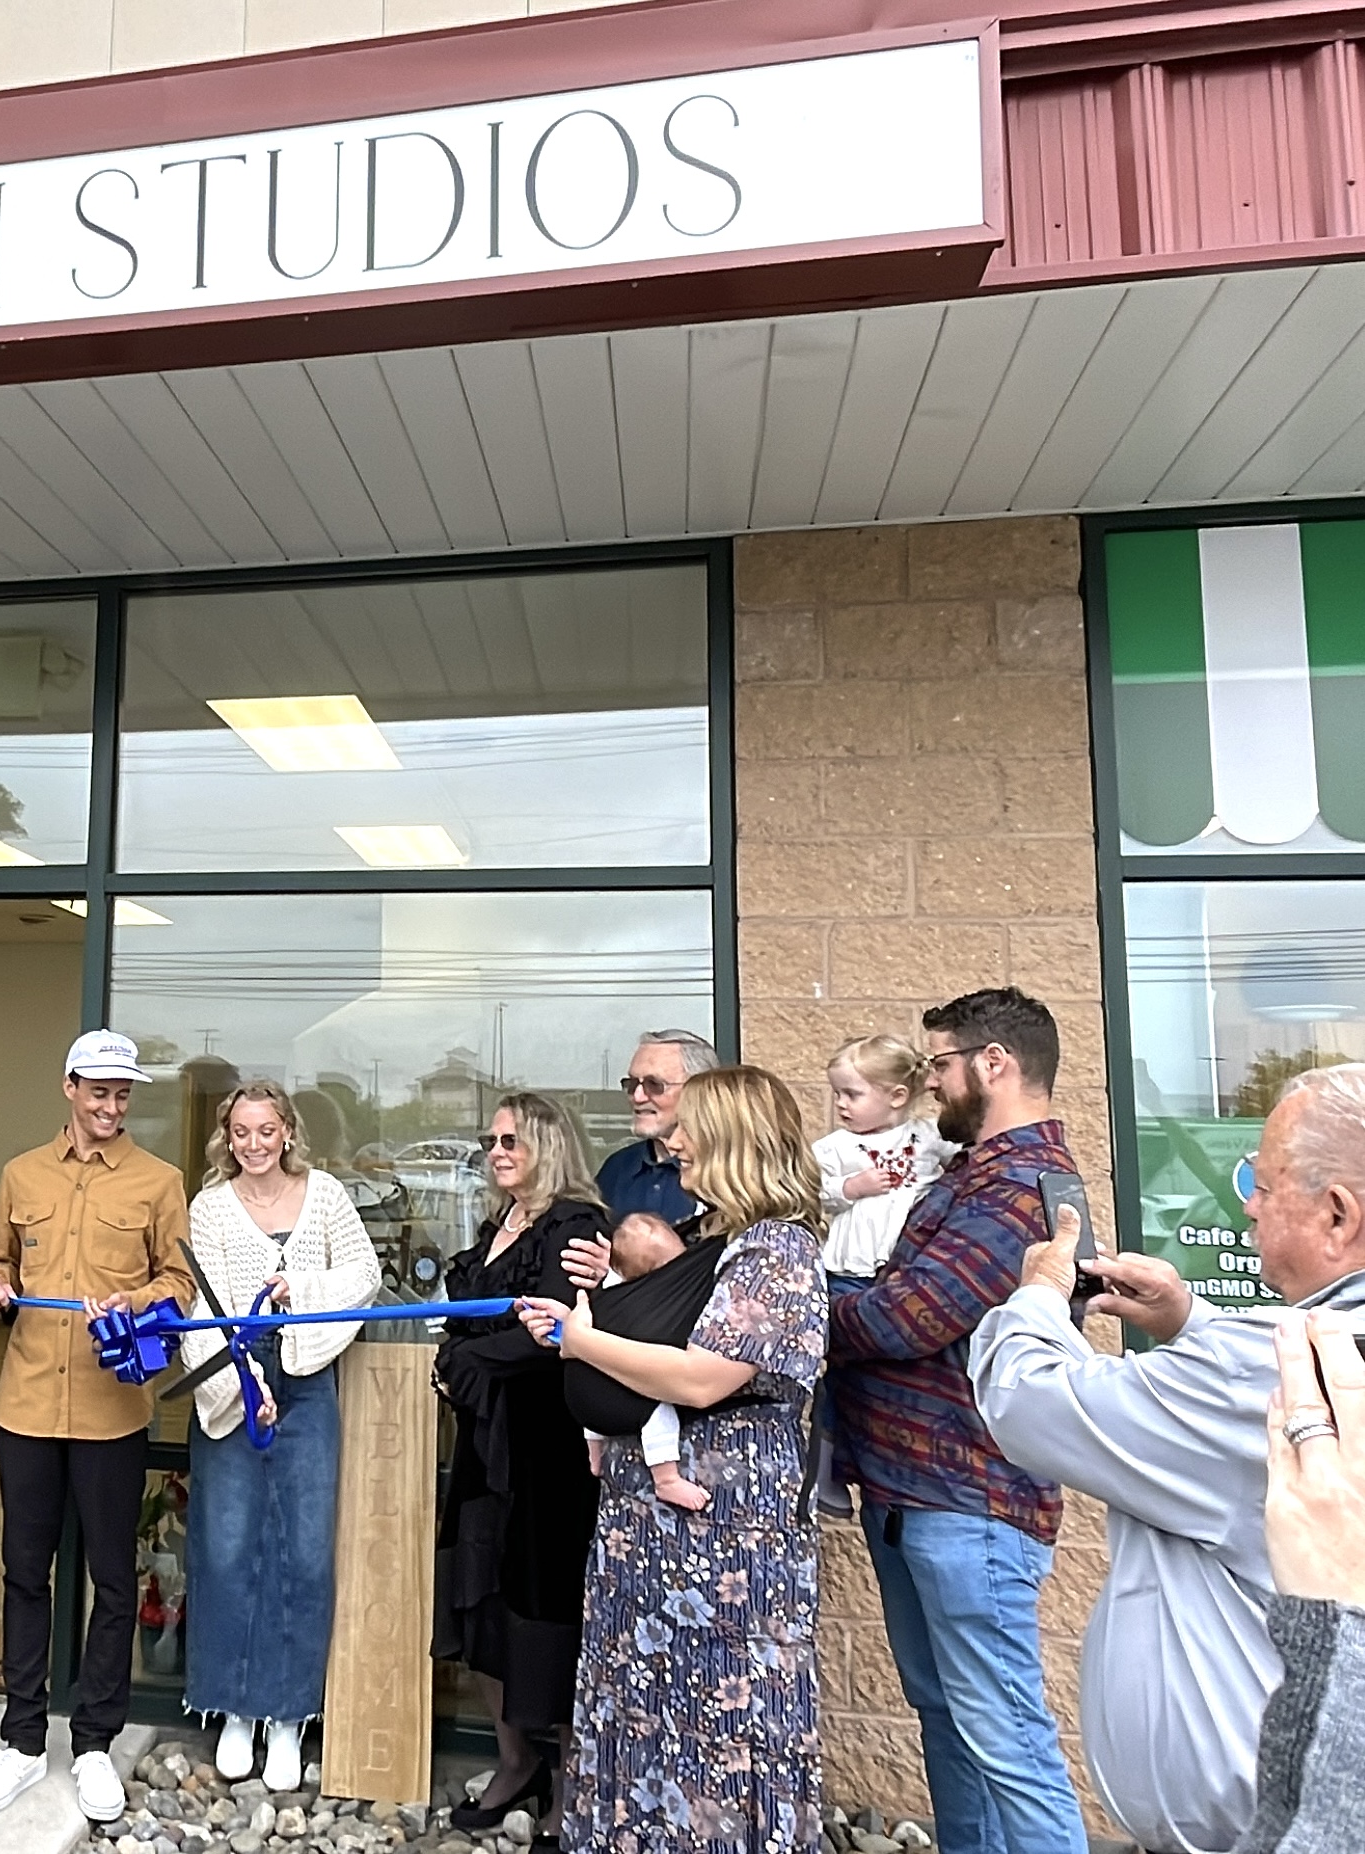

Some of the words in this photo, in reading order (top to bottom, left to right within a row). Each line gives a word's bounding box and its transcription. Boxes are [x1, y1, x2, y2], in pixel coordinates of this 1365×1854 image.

[71, 93, 743, 300] STUDIOS
[1179, 1225, 1236, 1246] Cafe
[365, 1366, 411, 1772] WELCOME
